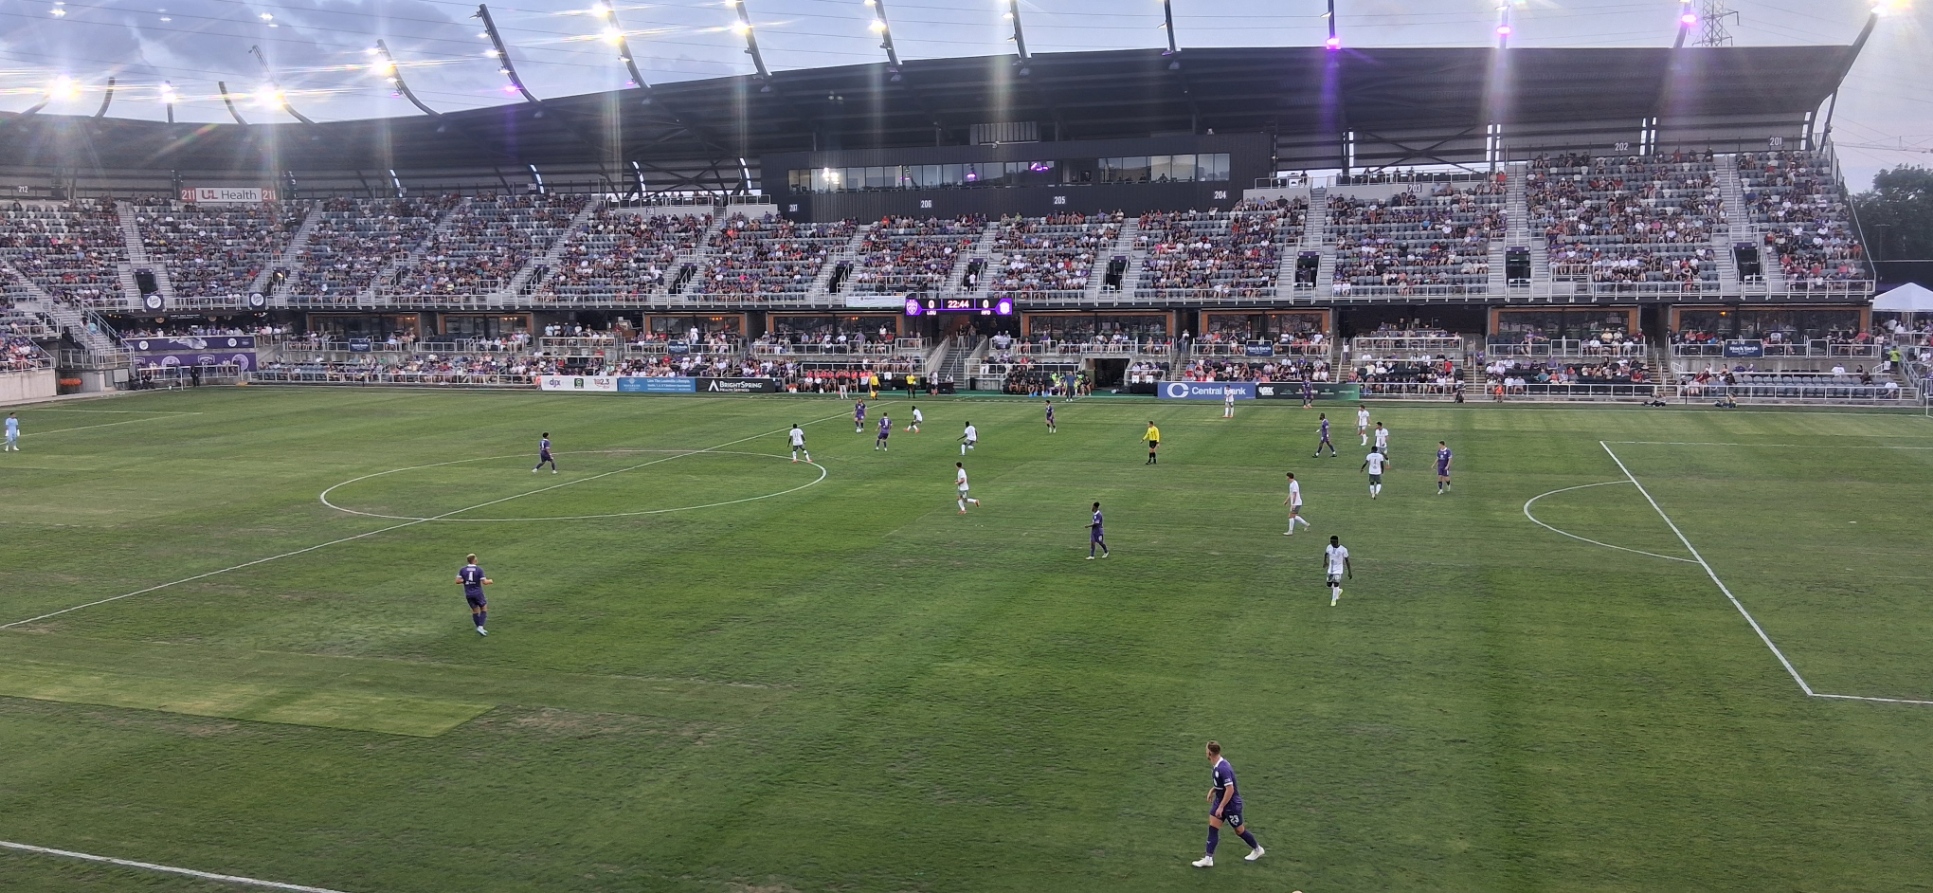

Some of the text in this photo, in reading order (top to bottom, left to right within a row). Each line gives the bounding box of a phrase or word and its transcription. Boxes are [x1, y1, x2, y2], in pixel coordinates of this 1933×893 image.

[1769, 137, 1783, 146] 201
[1614, 142, 1629, 151] 202
[18, 185, 29, 194] 212
[181, 189, 196, 201] 211
[221, 189, 257, 200] Health
[262, 189, 277, 201] 211
[1213, 190, 1227, 199] 204
[920, 199, 932, 208] 206
[1053, 195, 1066, 205] 205
[928, 299, 935, 309] 0
[947, 300, 969, 309] 22:44
[982, 299, 990, 309] 0
[1191, 386, 1223, 395] Central
